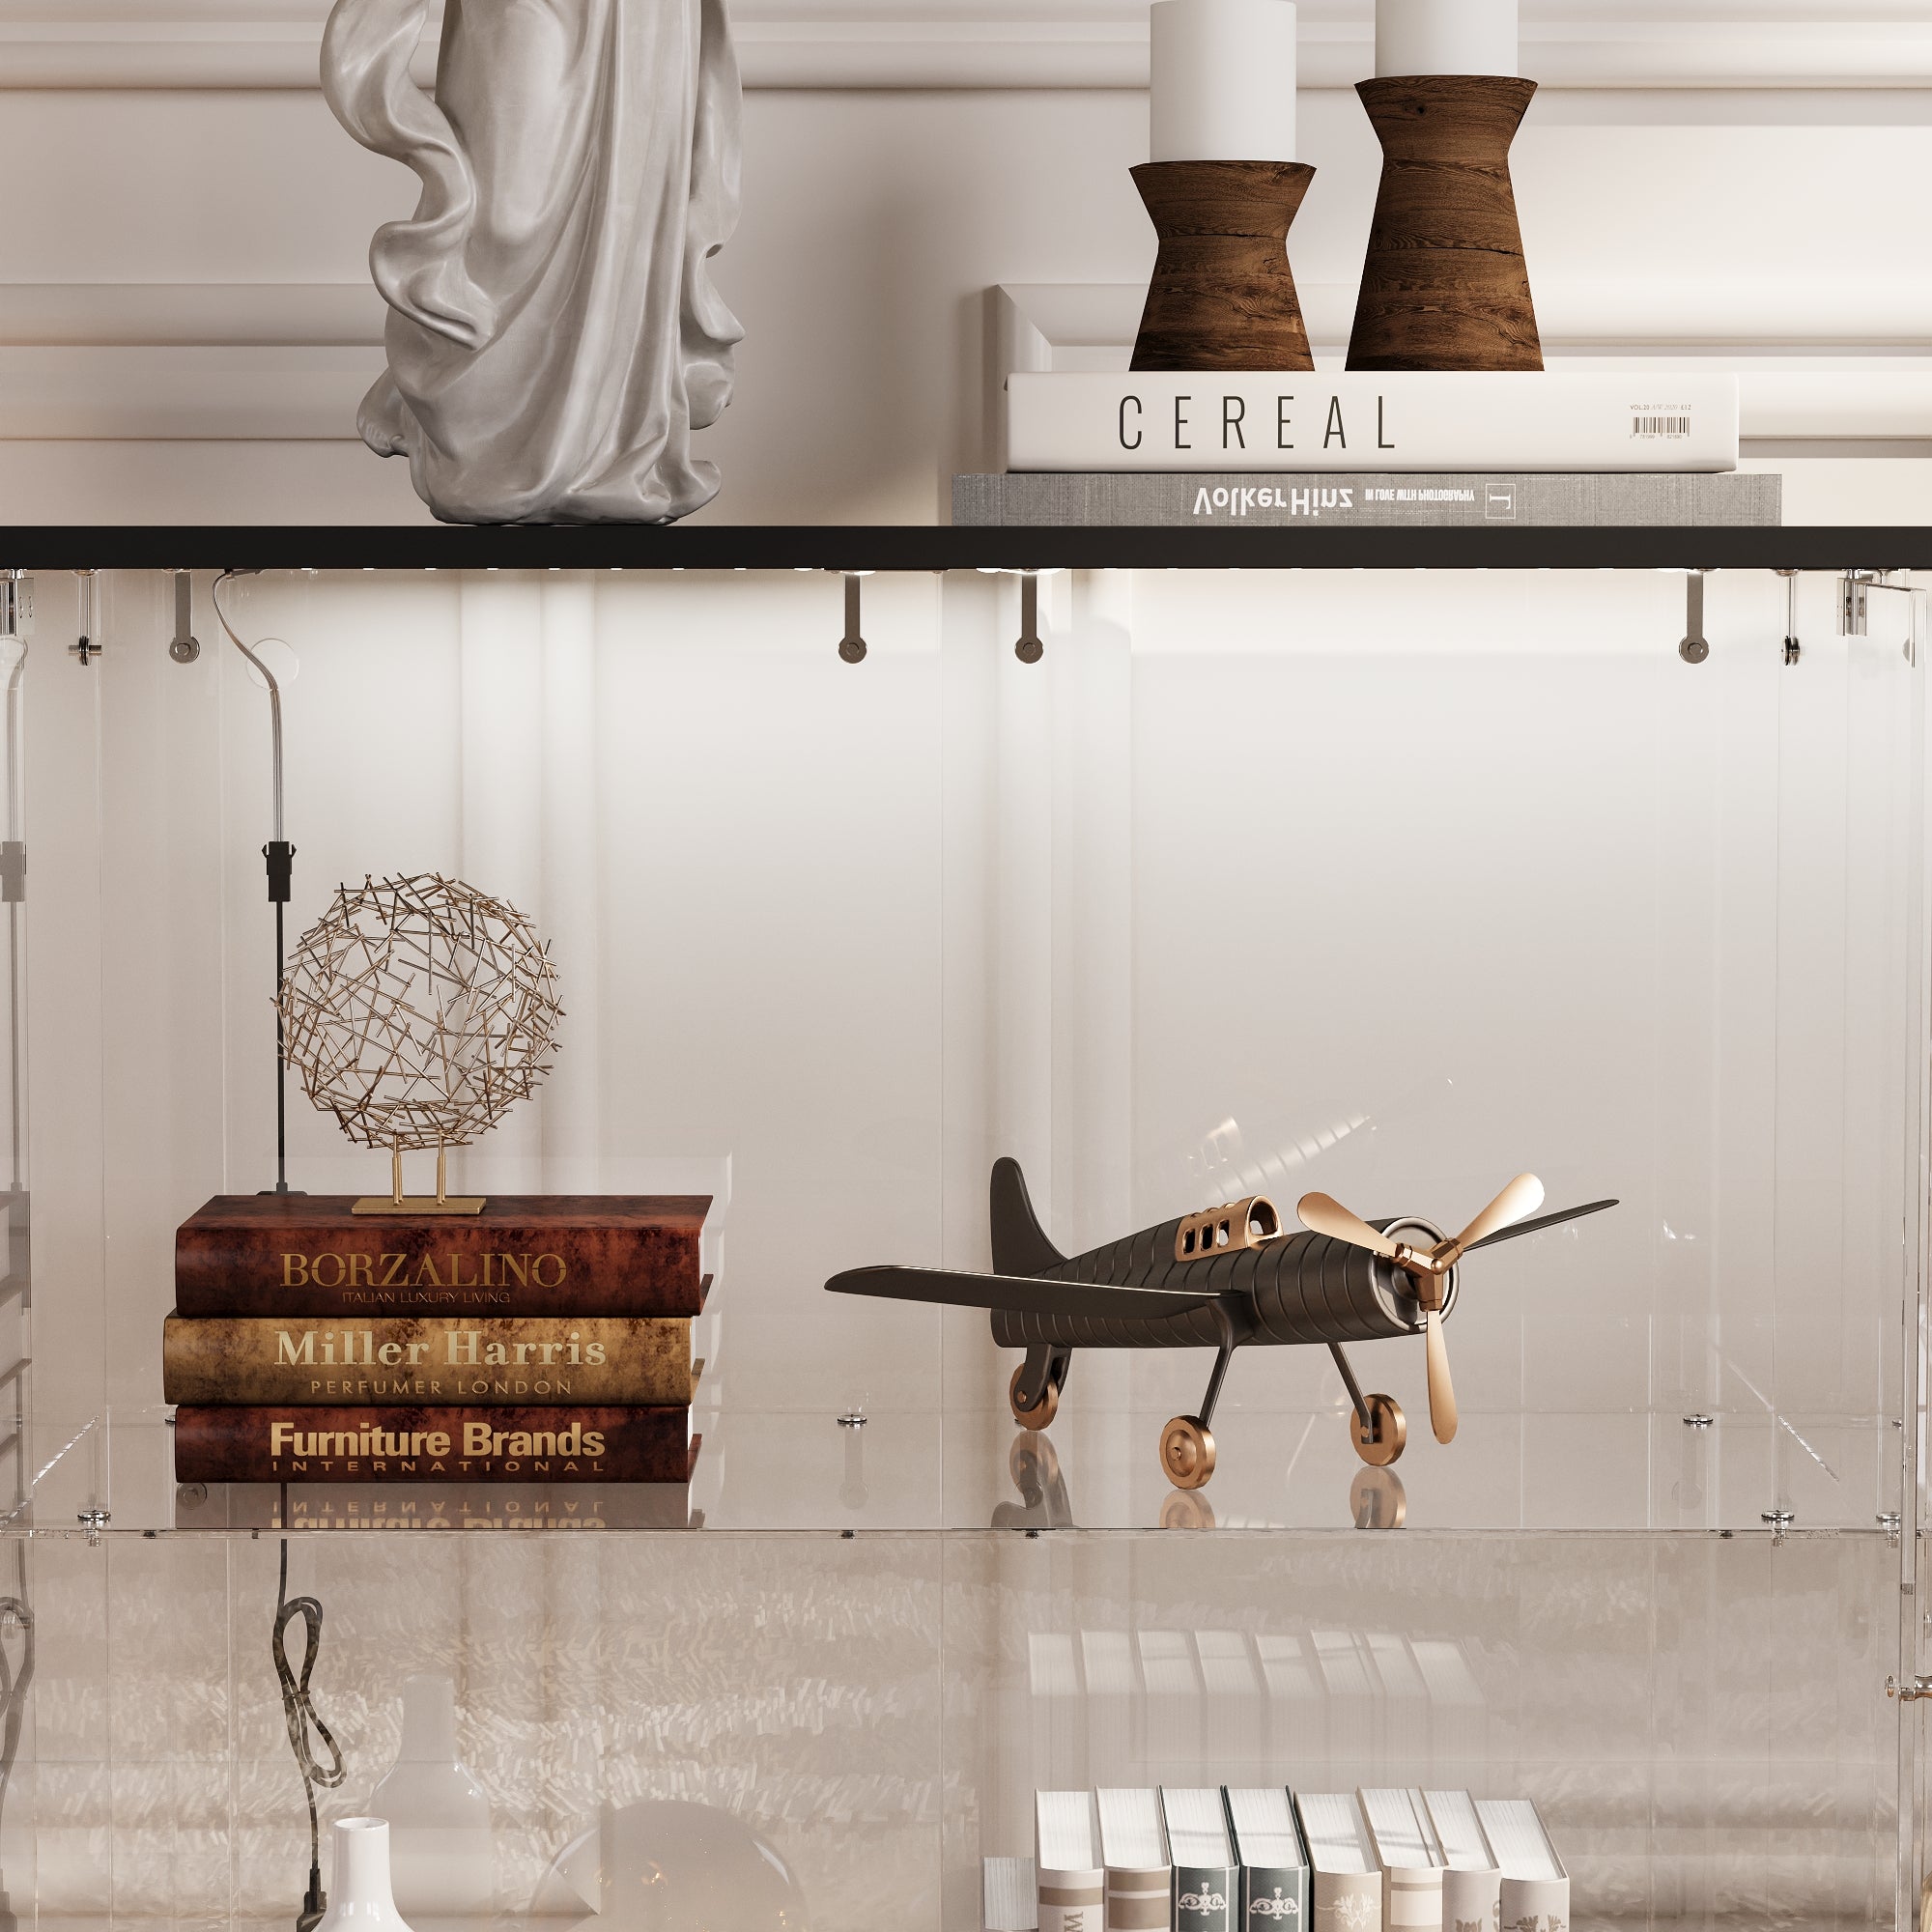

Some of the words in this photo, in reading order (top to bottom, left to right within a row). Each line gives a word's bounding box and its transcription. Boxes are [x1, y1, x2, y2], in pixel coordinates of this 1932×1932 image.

[1119, 395, 1395, 449] CEREAL
[279, 1253, 567, 1288] BORZALINO
[342, 1292, 395, 1303] ITALIAN
[400, 1292, 460, 1303] LUXURY
[464, 1292, 511, 1303] LIVING
[273, 1330, 430, 1366] Miller
[443, 1330, 607, 1366] Harris
[311, 1380, 441, 1395] PERFUMER
[459, 1379, 572, 1395] LONDON
[270, 1422, 451, 1457] Furniture
[463, 1422, 606, 1457] Brands
[272, 1461, 604, 1472] INTERNATIONAL
